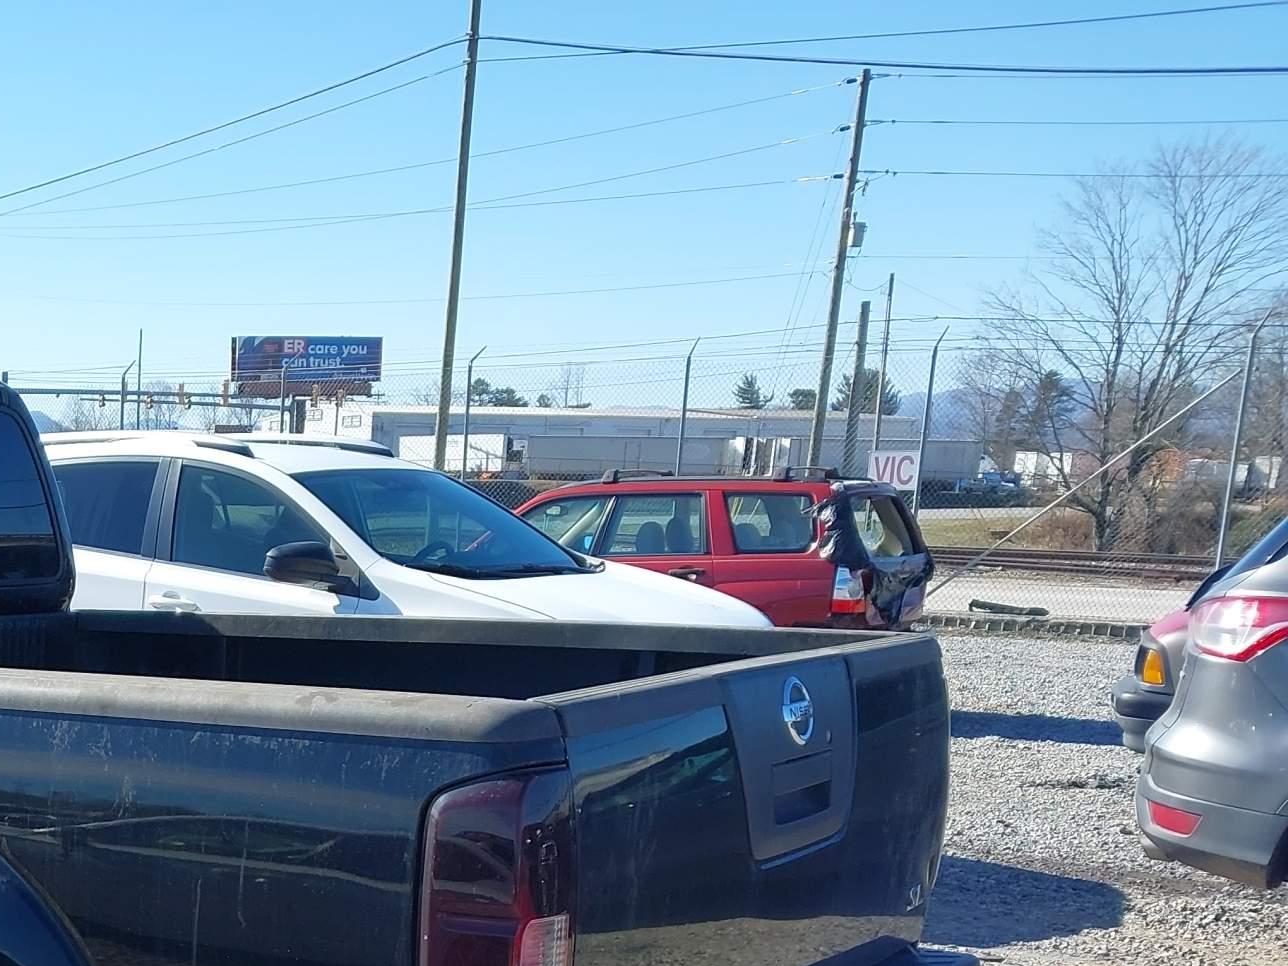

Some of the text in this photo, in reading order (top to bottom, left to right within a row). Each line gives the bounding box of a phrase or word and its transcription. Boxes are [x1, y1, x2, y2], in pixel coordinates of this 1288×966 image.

[284, 339, 305, 353] ER
[308, 344, 338, 354] care
[342, 344, 367, 357] you
[282, 356, 345, 368] can trust.
[874, 455, 915, 486] VIC
